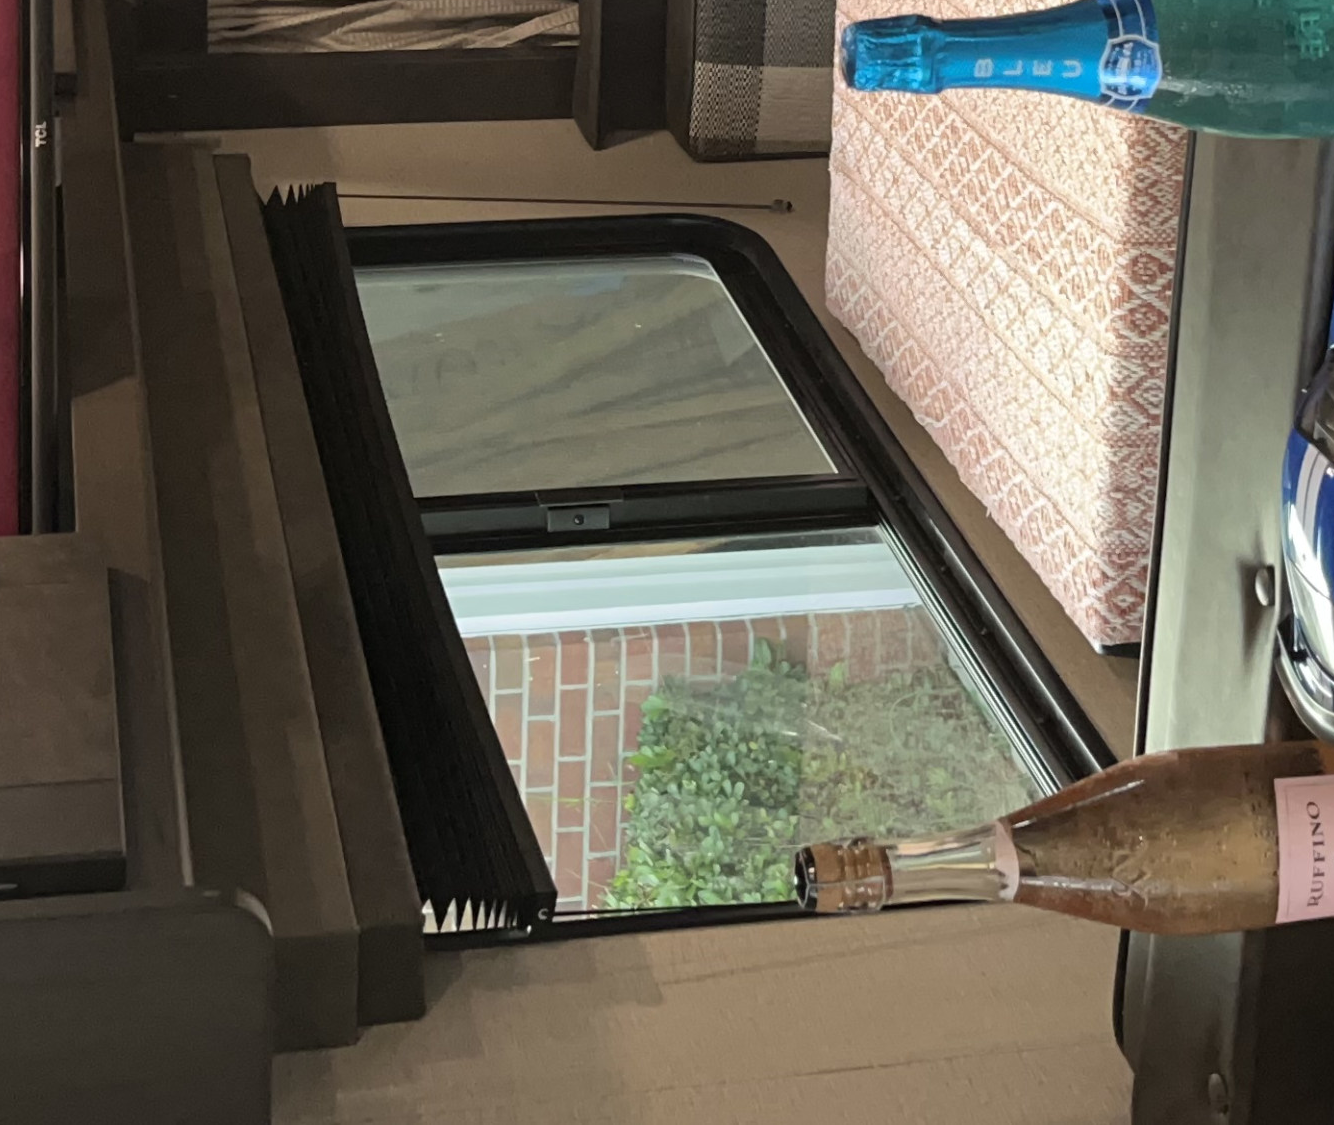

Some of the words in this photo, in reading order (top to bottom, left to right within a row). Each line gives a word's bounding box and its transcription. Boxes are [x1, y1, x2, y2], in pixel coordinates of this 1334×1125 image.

[974, 58, 1082, 78] BLEU
[34, 121, 47, 147] TCL
[1306, 801, 1326, 907] RUFFINO
